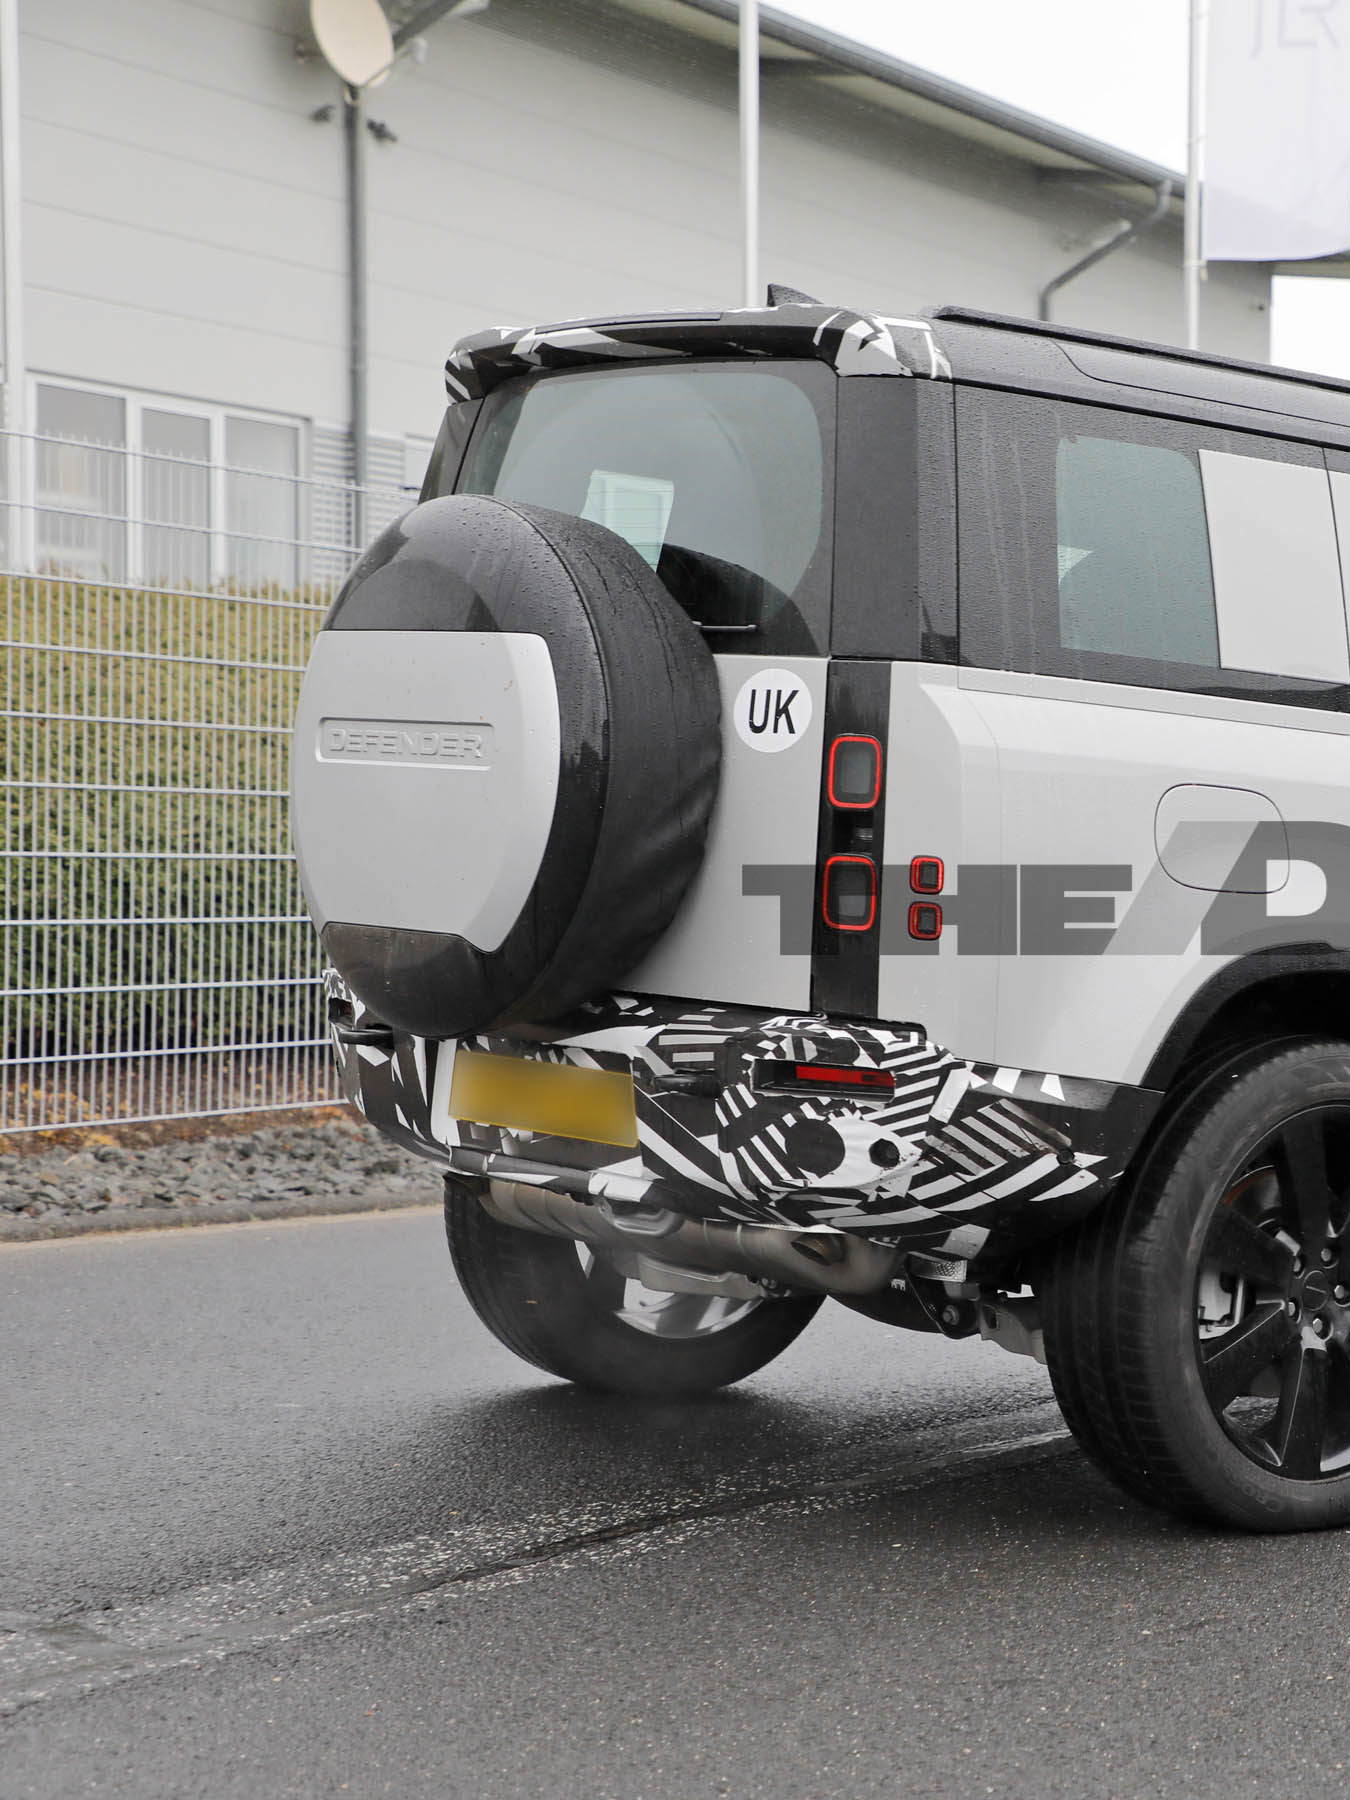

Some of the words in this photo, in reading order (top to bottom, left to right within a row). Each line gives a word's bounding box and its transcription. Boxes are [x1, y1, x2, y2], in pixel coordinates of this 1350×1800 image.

[1248, 0, 1341, 59] JLR
[748, 688, 800, 735] UK
[328, 727, 484, 760] DEFENDER
